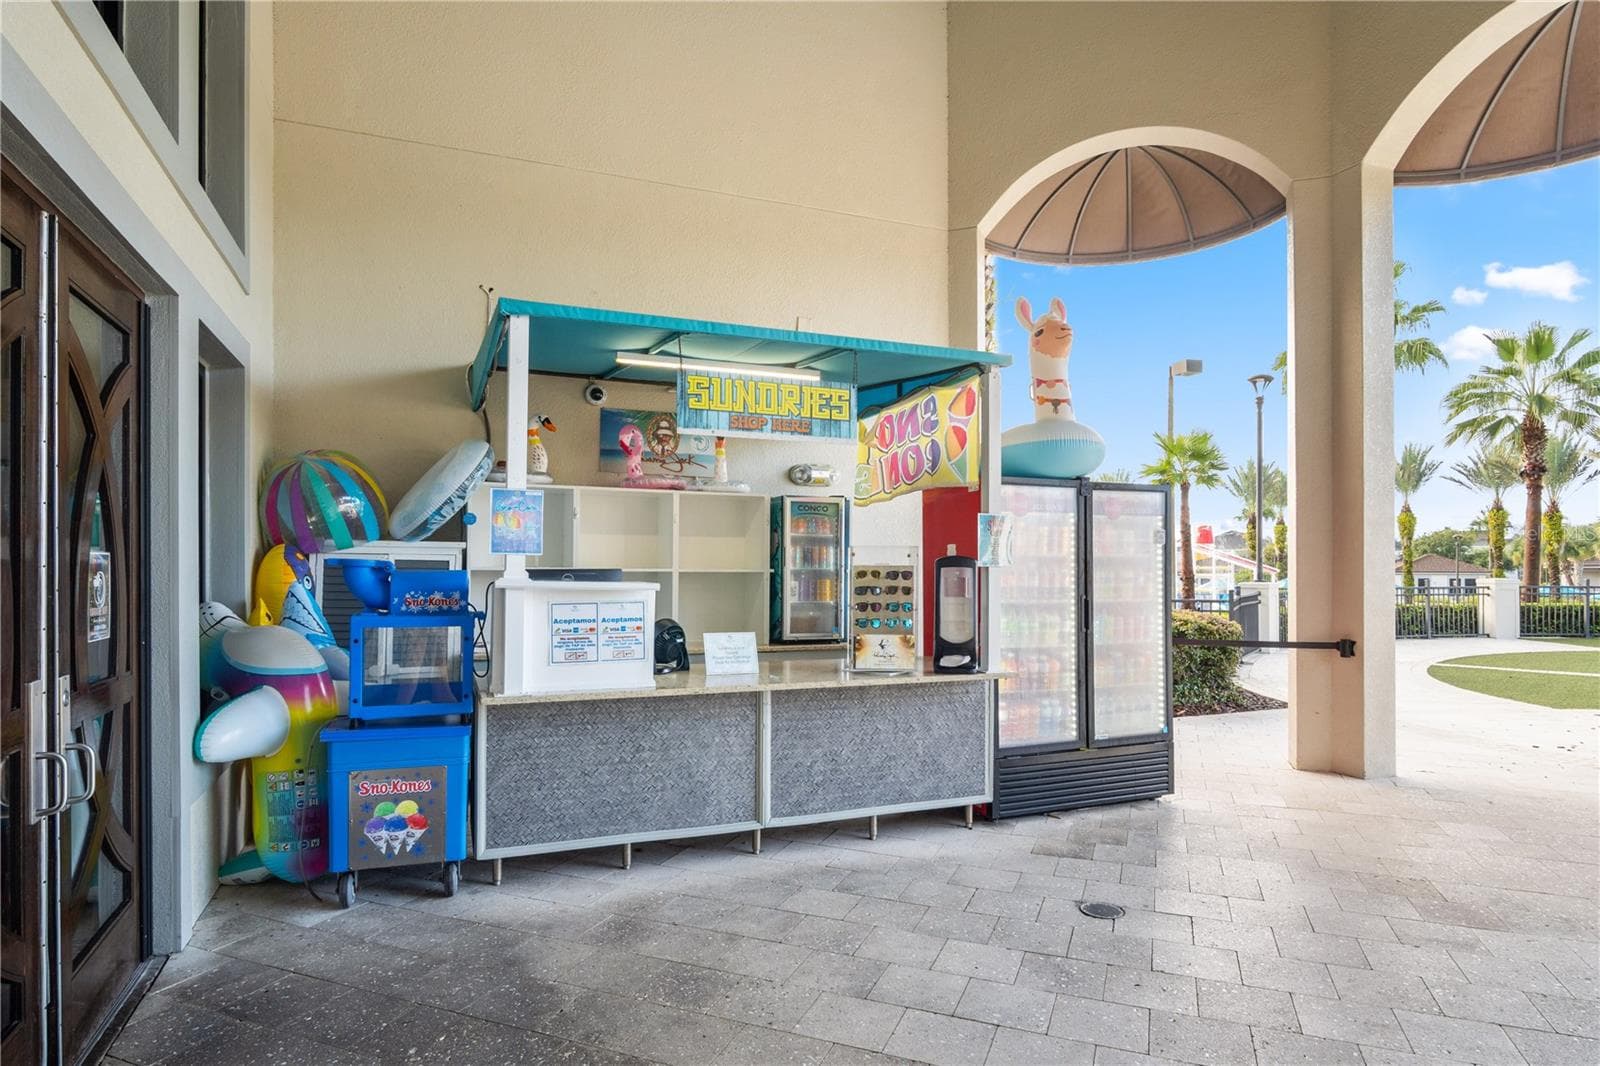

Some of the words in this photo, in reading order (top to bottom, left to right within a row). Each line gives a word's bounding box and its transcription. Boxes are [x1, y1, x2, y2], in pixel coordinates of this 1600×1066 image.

[687, 375, 850, 421] SUNDRIES
[730, 415, 768, 431] SHOP
[771, 417, 811, 433] HERE
[553, 617, 596, 625] Aceptamos
[601, 616, 643, 624] Aceptamos
